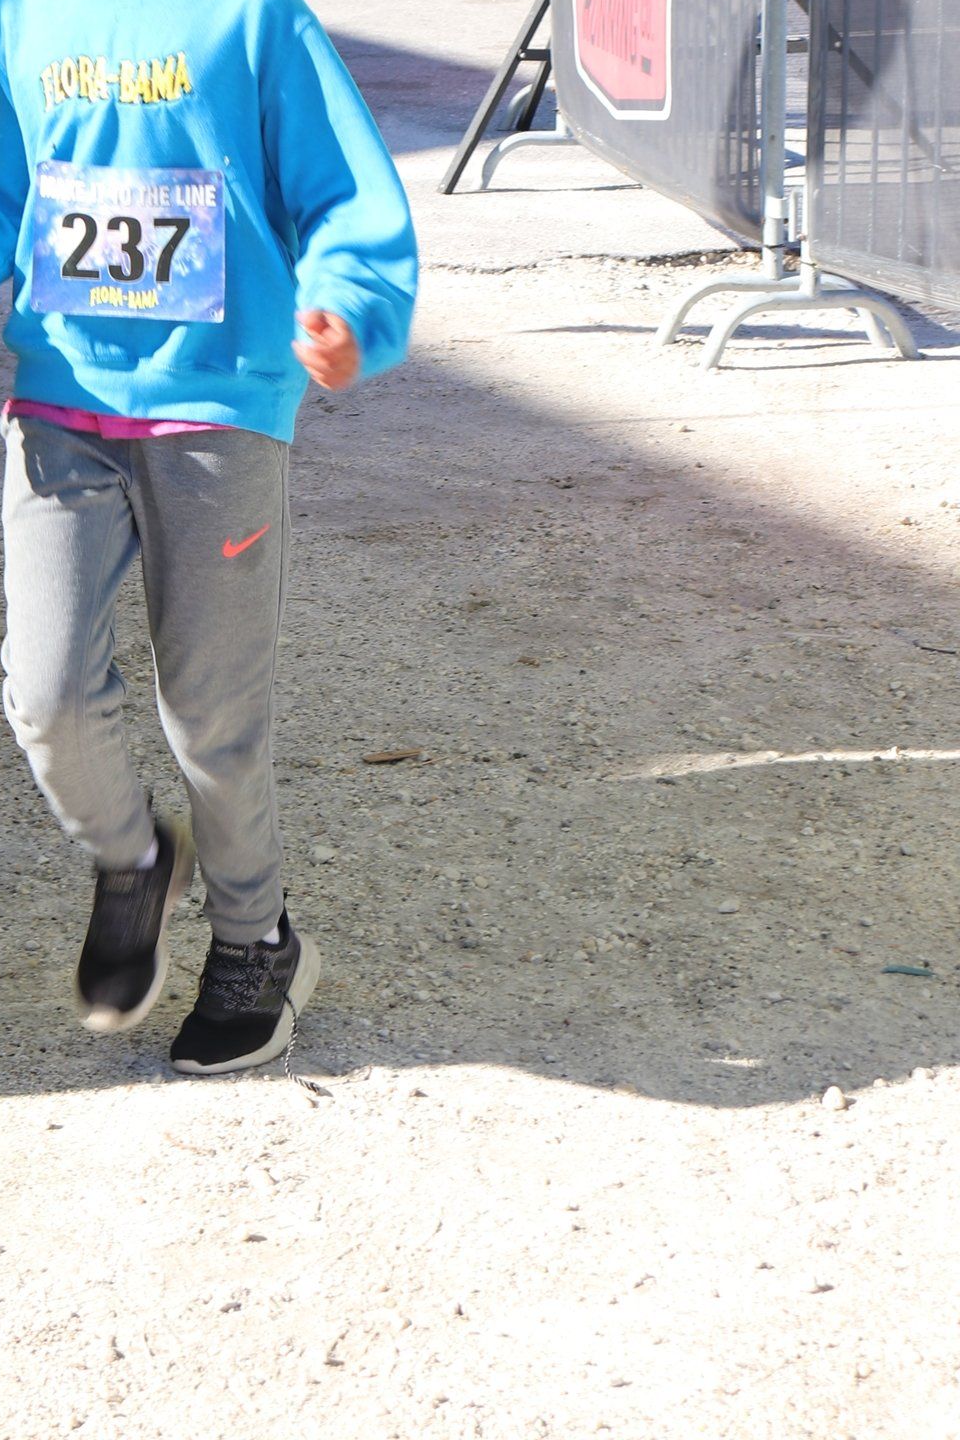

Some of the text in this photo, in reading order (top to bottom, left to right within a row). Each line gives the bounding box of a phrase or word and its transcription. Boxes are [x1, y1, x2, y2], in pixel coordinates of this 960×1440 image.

[40, 51, 192, 112] FLORA-BAMA
[135, 184, 171, 208] THE
[175, 184, 217, 208] LINE
[61, 213, 191, 285] 237
[90, 286, 159, 310] FLORA-BAMA
